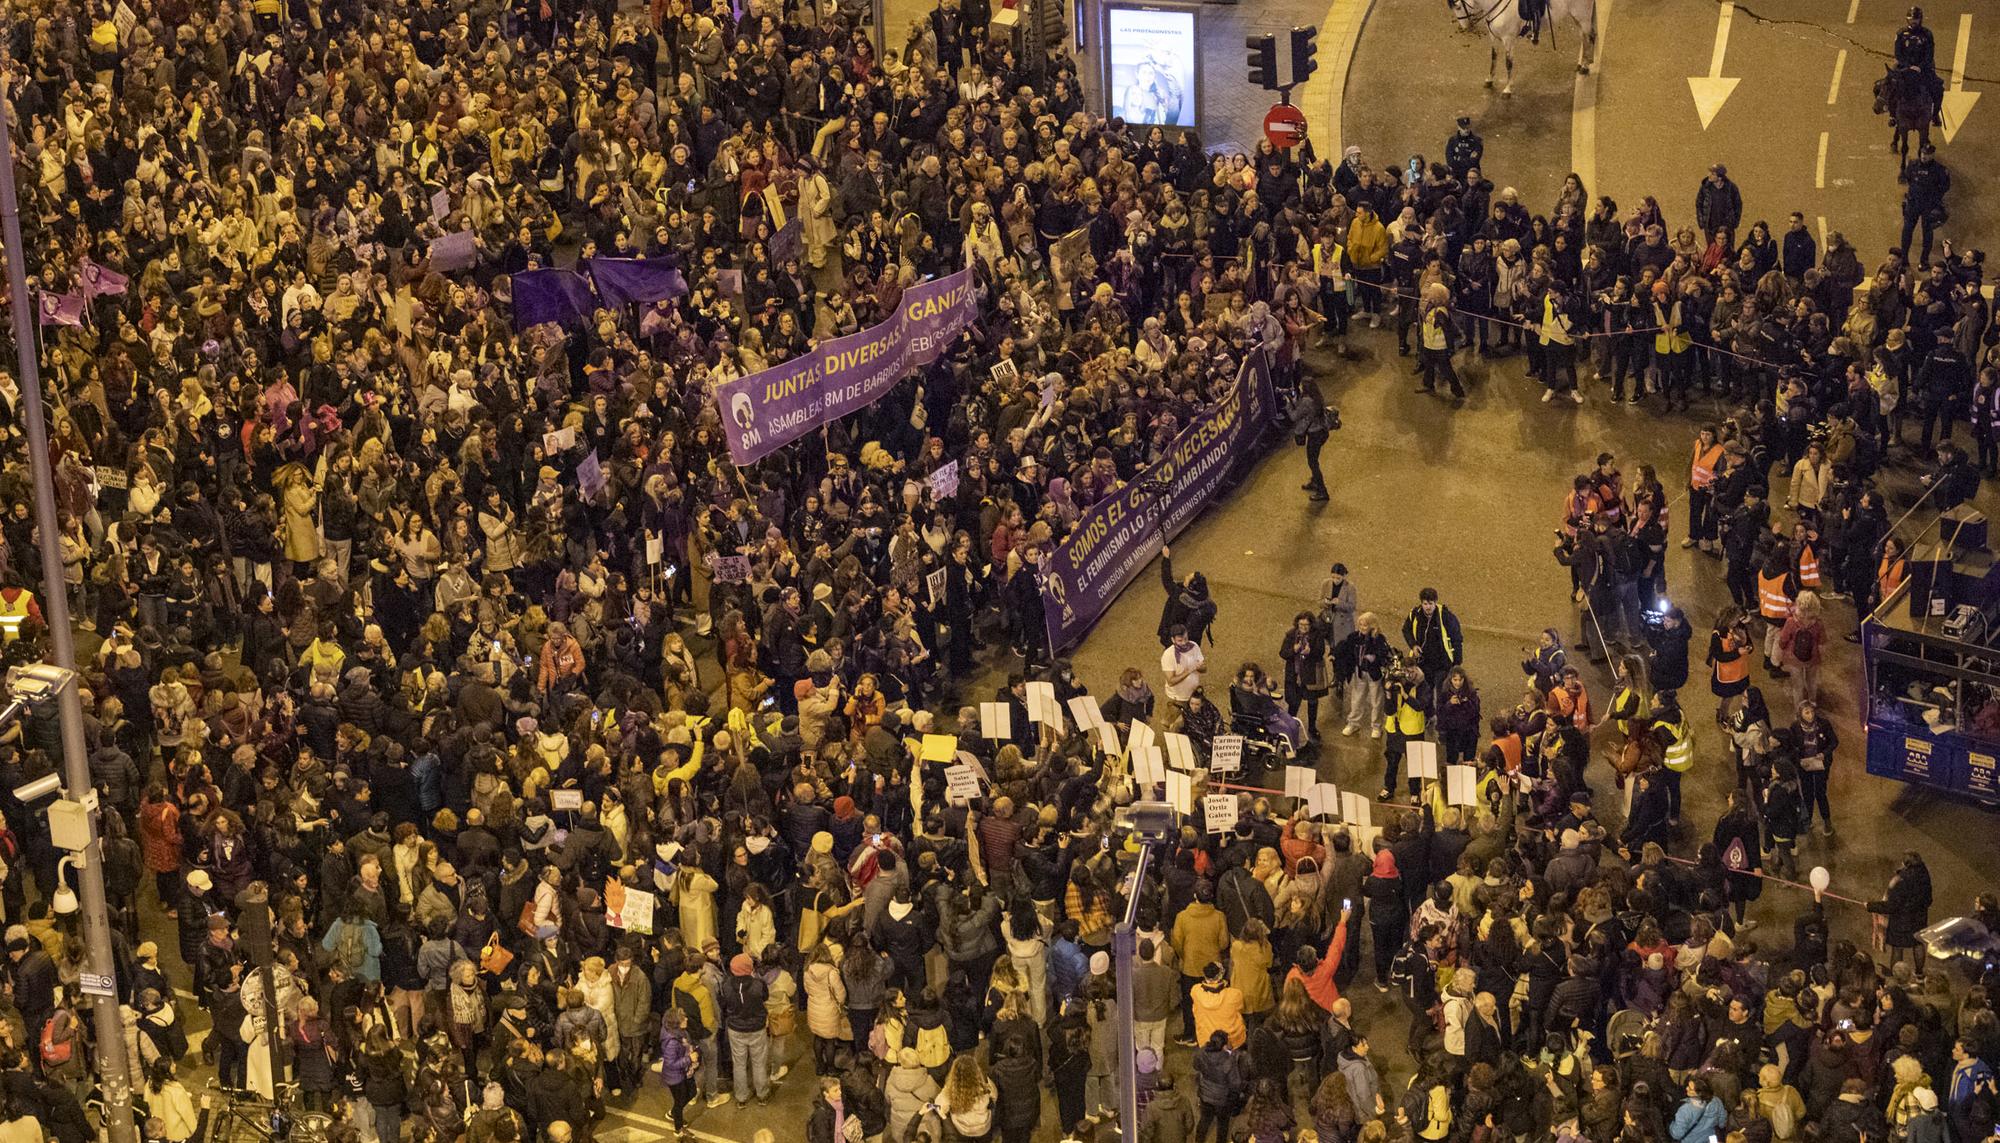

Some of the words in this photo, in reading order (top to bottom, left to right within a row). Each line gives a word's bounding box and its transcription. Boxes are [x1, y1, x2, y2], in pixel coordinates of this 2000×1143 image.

[768, 399, 823, 436] ASAMBLEAS
[825, 389, 843, 407] 8M
[847, 382, 861, 400] DE
[864, 357, 900, 392] BARRIOS
[741, 428, 762, 450] 8M
[1069, 515, 1108, 570] SOMOS
[1108, 500, 1126, 527] EL
[1077, 575, 1089, 593] EL
[1086, 528, 1130, 581] FEMINISMO
[1130, 515, 1144, 535] LO
[1174, 441, 1227, 498] CAMBIANDO
[1124, 556, 1134, 571] 8M
[1171, 488, 1206, 523] FEMINISTA
[1206, 482, 1216, 493] DE
[1215, 751, 1240, 759] Aguado
[1208, 811, 1232, 819] Galera
